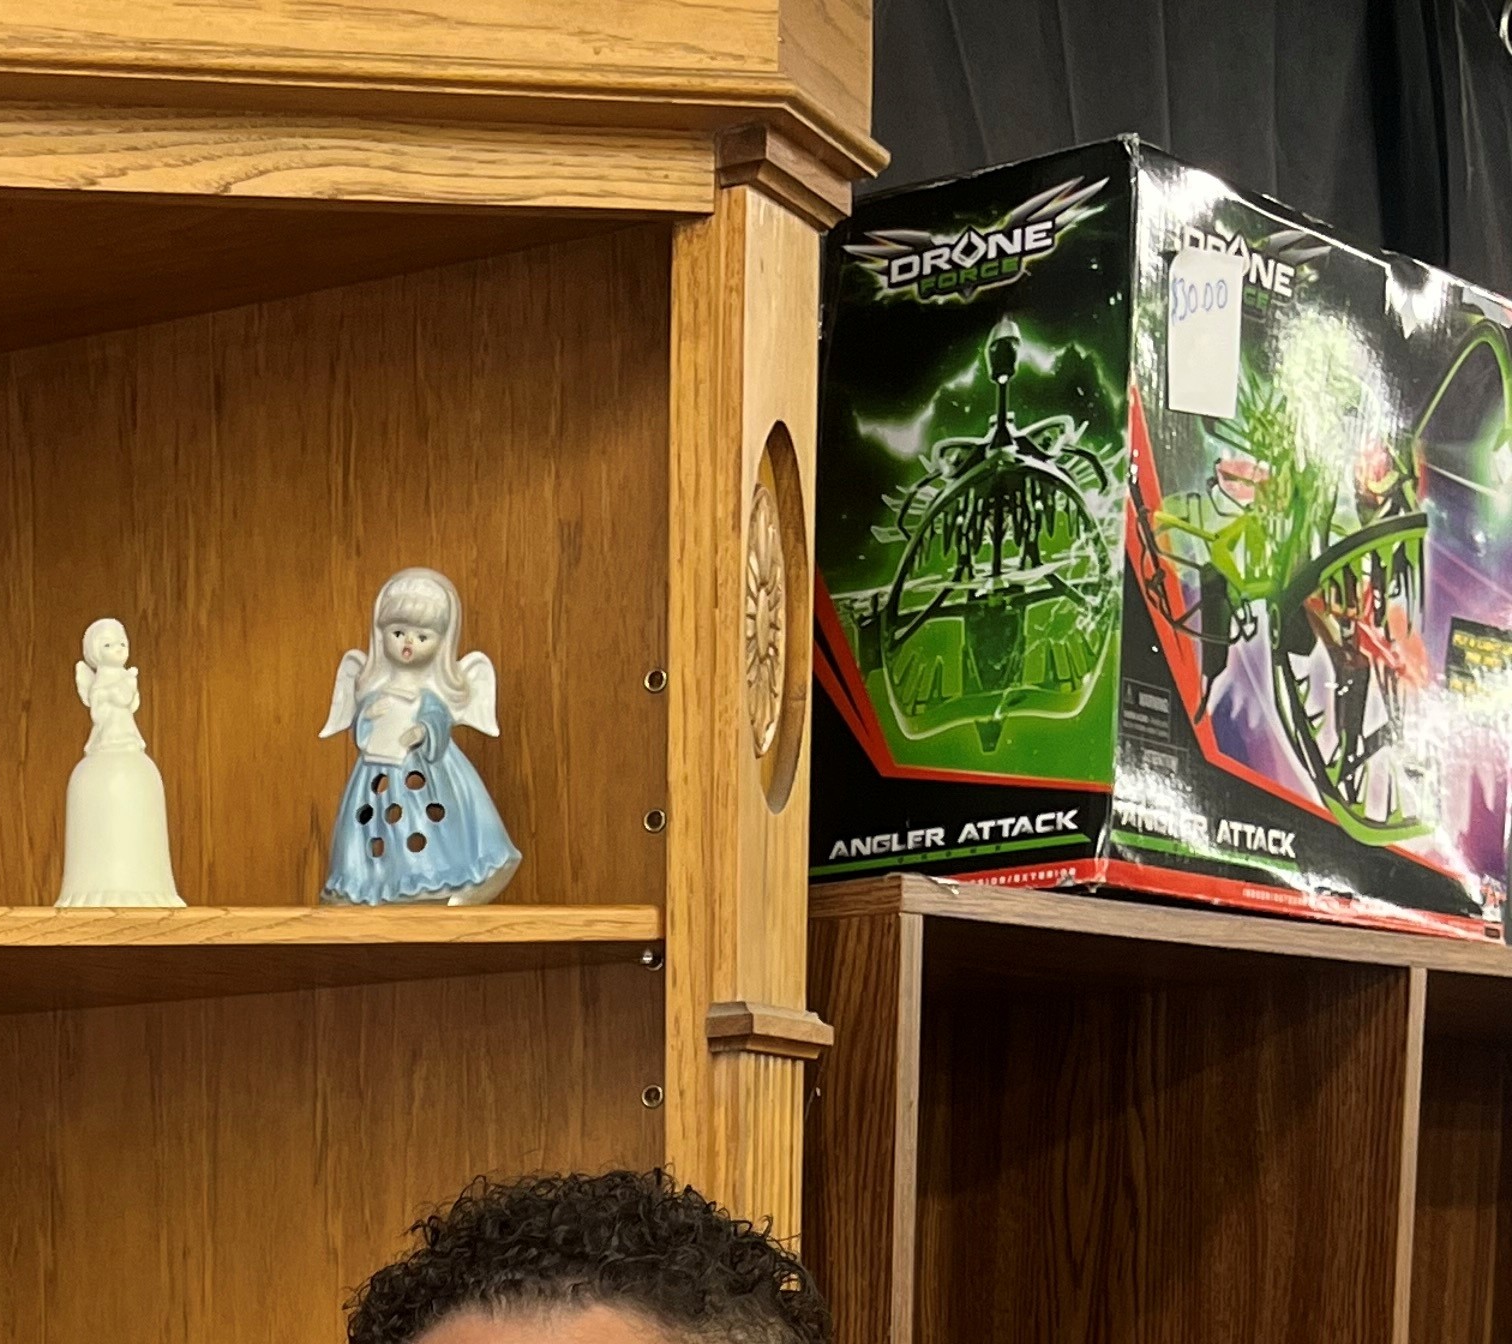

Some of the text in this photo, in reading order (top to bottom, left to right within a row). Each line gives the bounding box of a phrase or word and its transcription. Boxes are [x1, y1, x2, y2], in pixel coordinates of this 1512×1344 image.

[889, 221, 1053, 283] DRONE
[919, 257, 1019, 293] FORCE
[829, 826, 945, 860] ANGLER
[957, 809, 1079, 843] ATTACK
[1216, 818, 1296, 858] ATTACK
